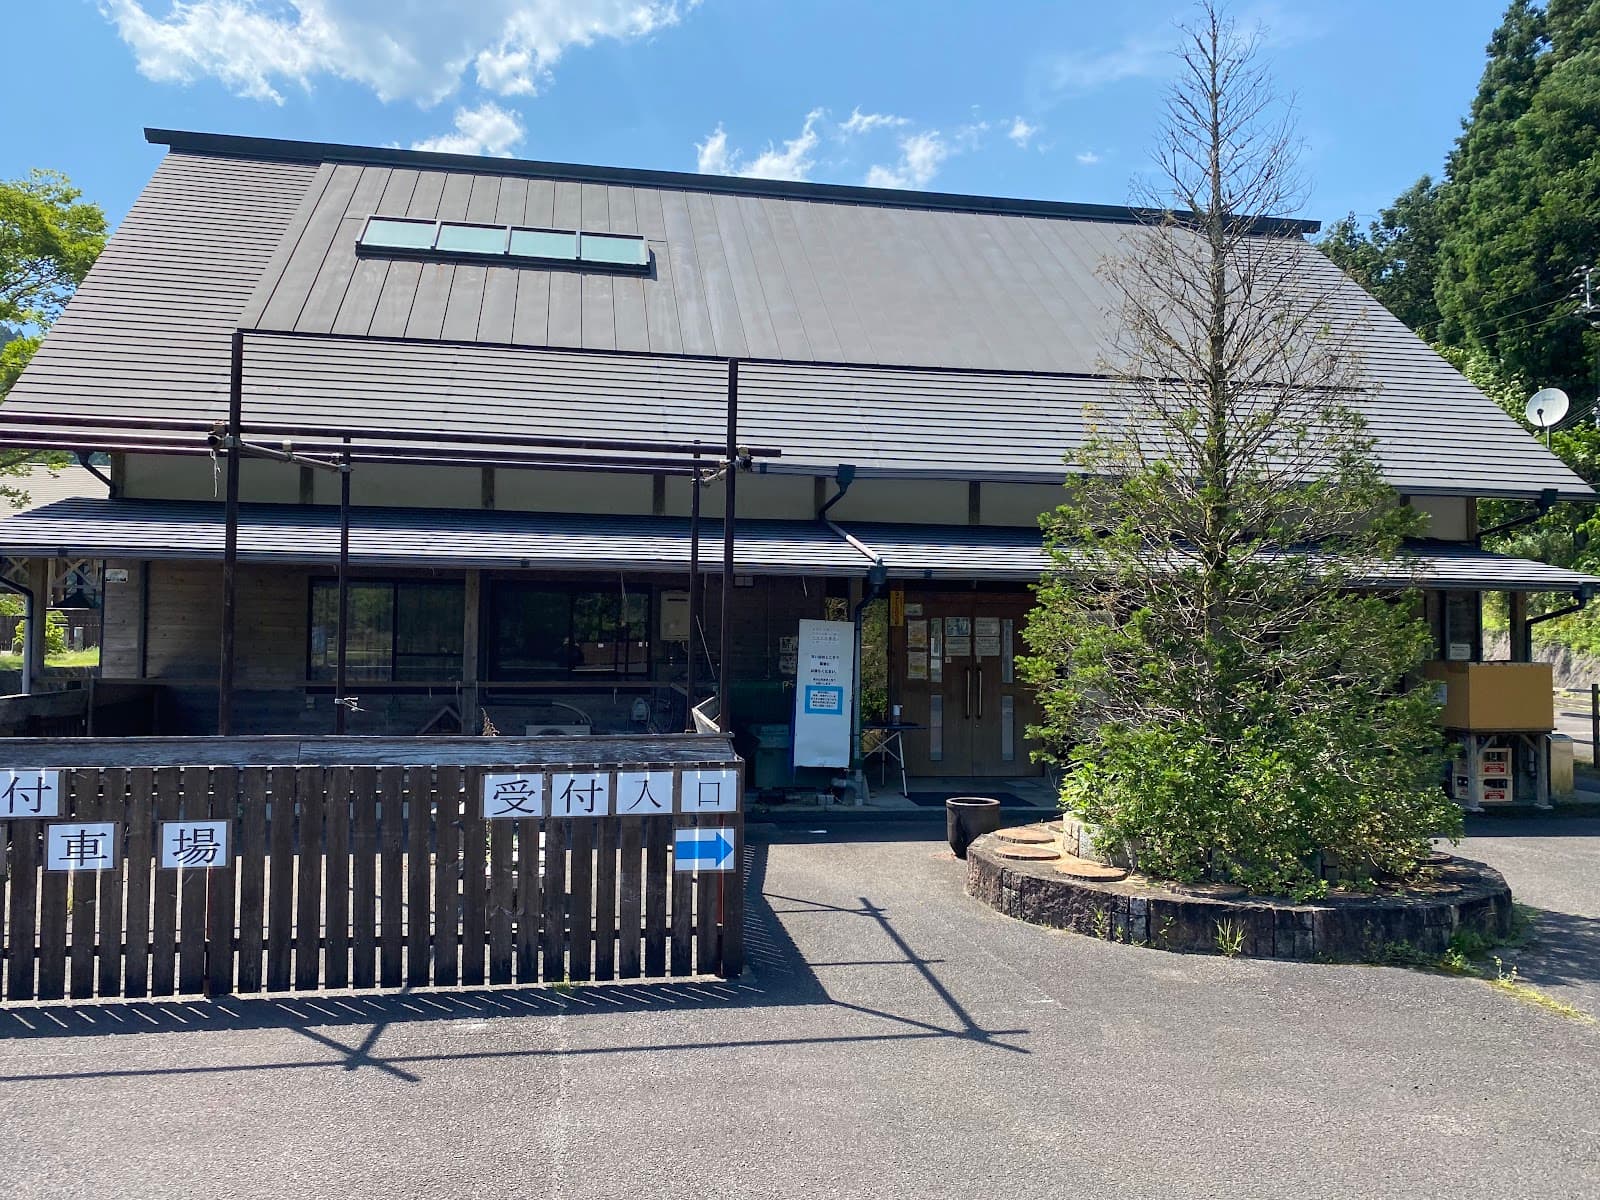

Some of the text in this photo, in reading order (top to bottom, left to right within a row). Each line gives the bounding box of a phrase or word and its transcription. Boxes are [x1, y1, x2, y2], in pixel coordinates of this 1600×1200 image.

[1, 776, 53, 814] 付
[493, 779, 720, 815] 受付入口
